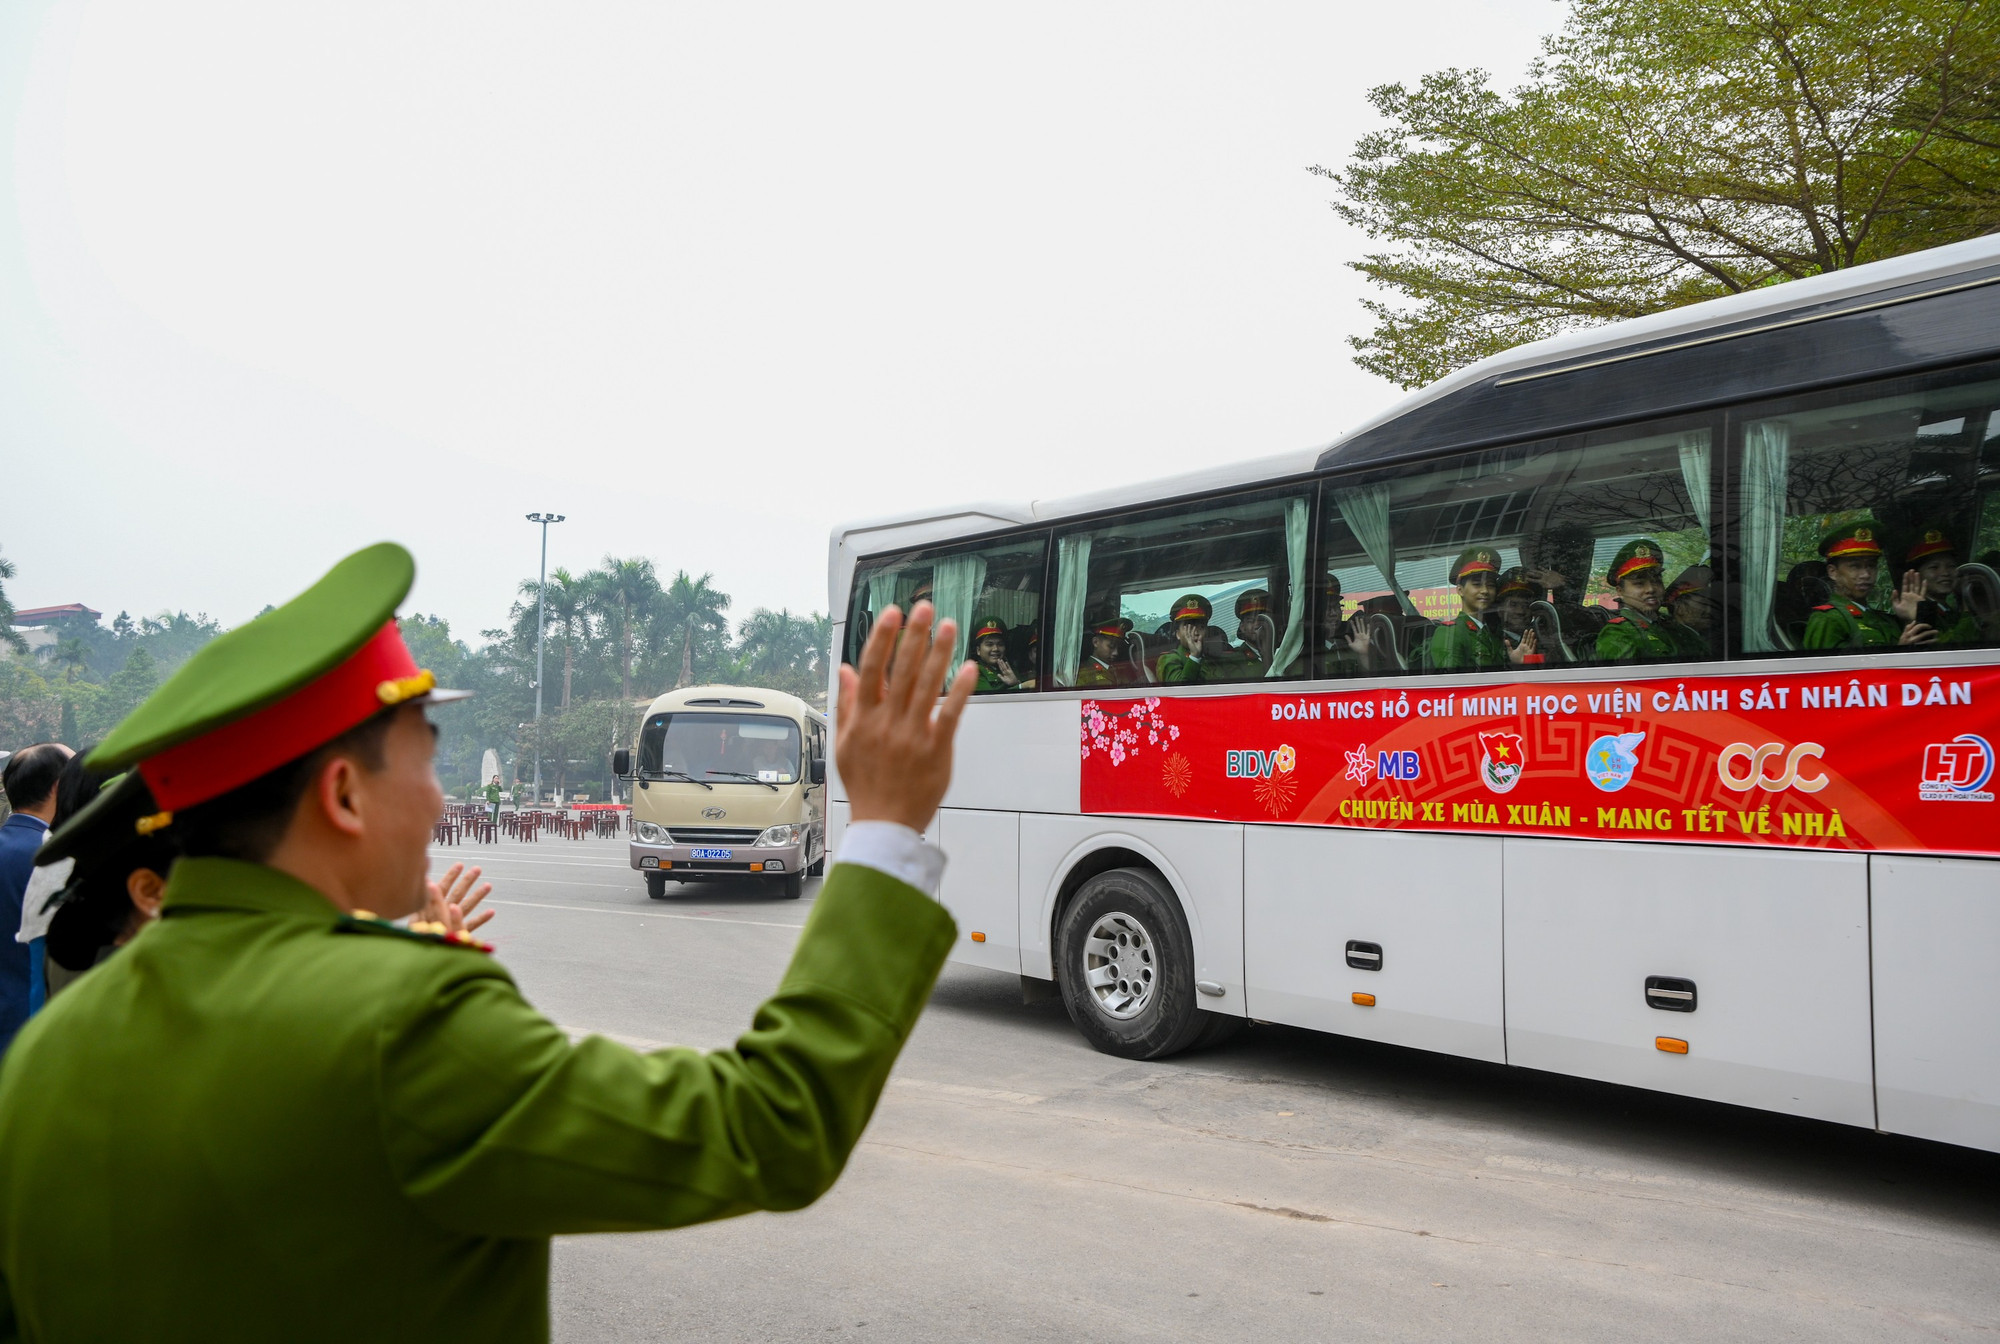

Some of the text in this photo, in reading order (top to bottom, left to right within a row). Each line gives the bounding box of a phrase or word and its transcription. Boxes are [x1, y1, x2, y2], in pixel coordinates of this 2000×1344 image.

[1271, 676, 1972, 721] ĐOÀN TNCS HỒ CHÍ MINH HỌC VIỆN CẢNH SÁT NHÂN DÂN
[1227, 750, 1277, 778] BIDV
[1378, 751, 1420, 779] MB
[1339, 795, 1414, 821] CHUYẾN
[1420, 801, 1446, 822] XE
[1452, 799, 1500, 824] MÙA
[1506, 801, 1571, 827] XUÂN
[1596, 807, 1672, 831] MANG
[1681, 803, 1728, 833] TẾT
[1738, 804, 1772, 835] VỀ
[1781, 808, 1847, 838] NHÀ
